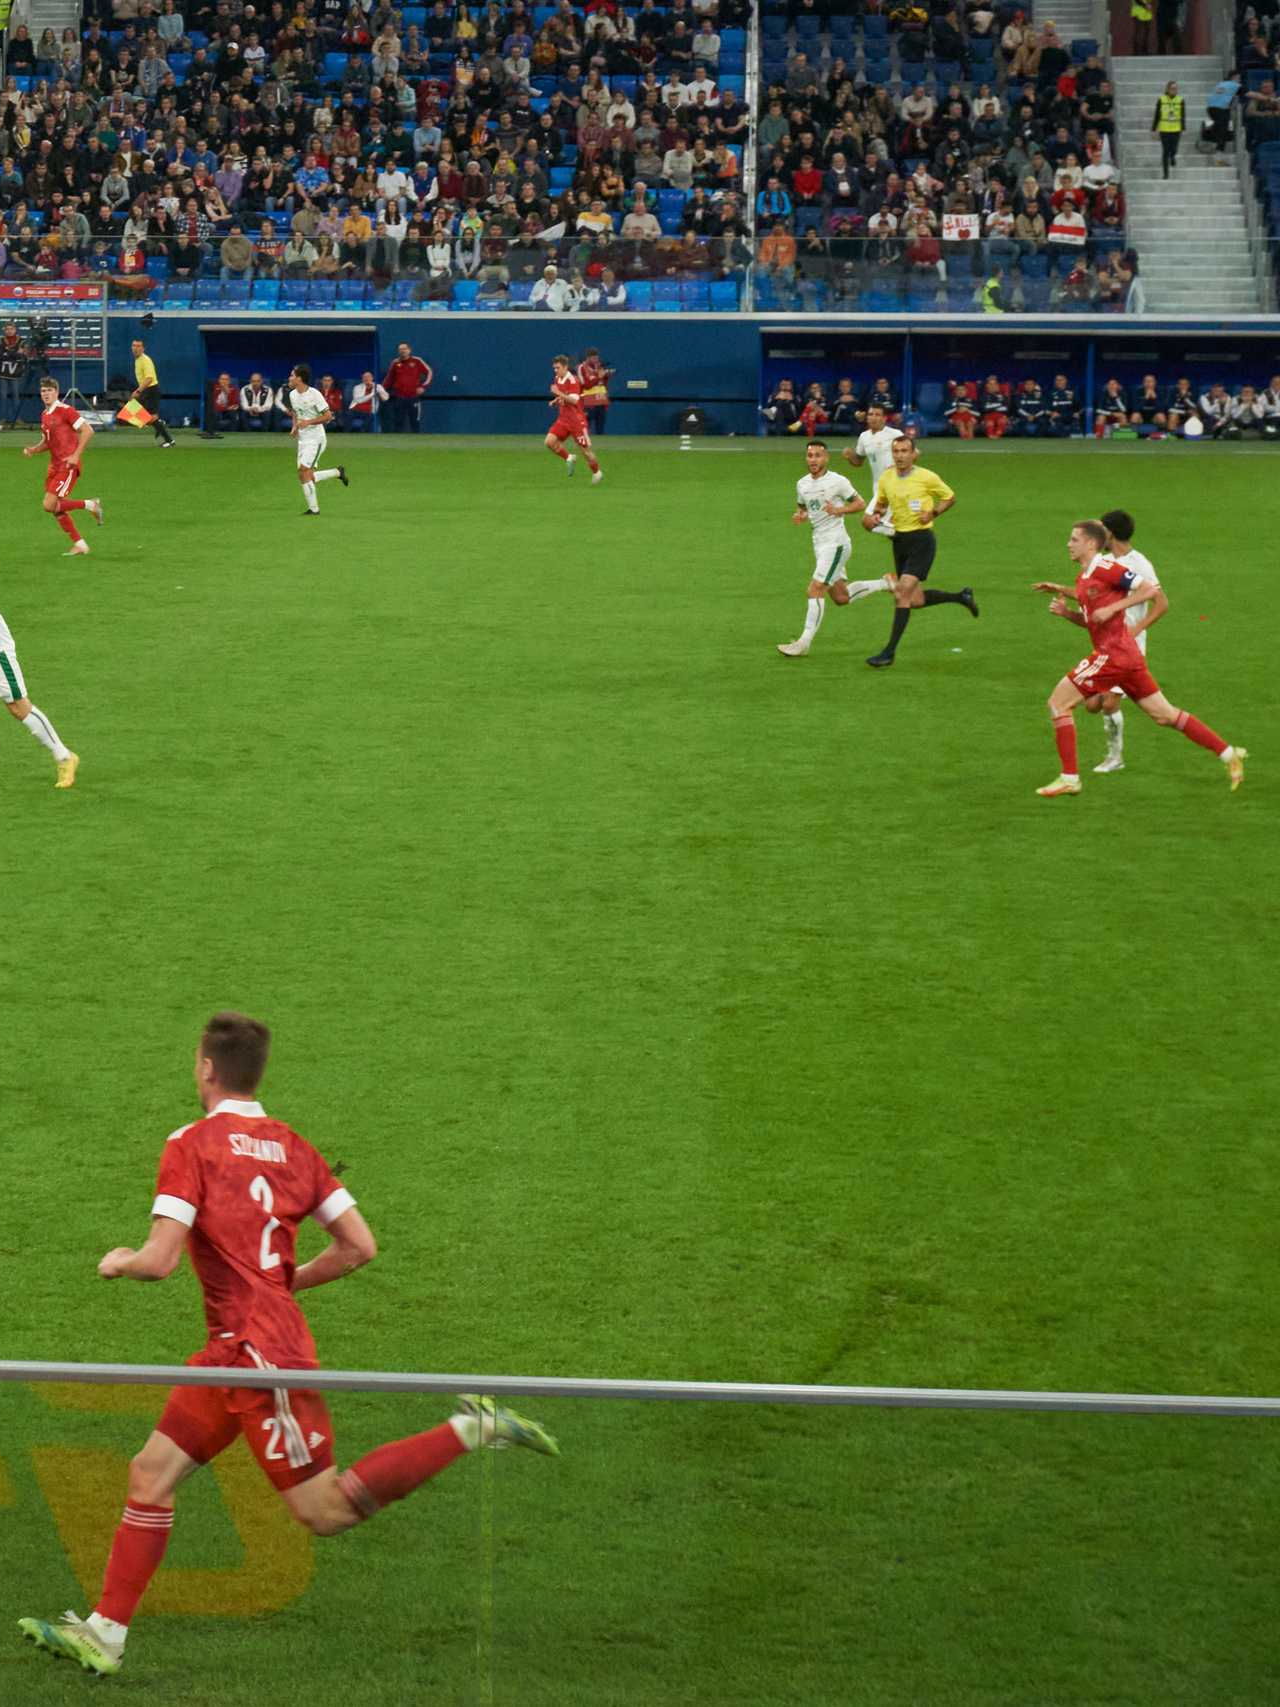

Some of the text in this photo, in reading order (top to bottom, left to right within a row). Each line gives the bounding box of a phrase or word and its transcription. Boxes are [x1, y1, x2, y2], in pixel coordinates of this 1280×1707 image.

[1, 361, 18, 374] TV
[249, 1175, 282, 1270] 2
[261, 1417, 285, 1460] 2
